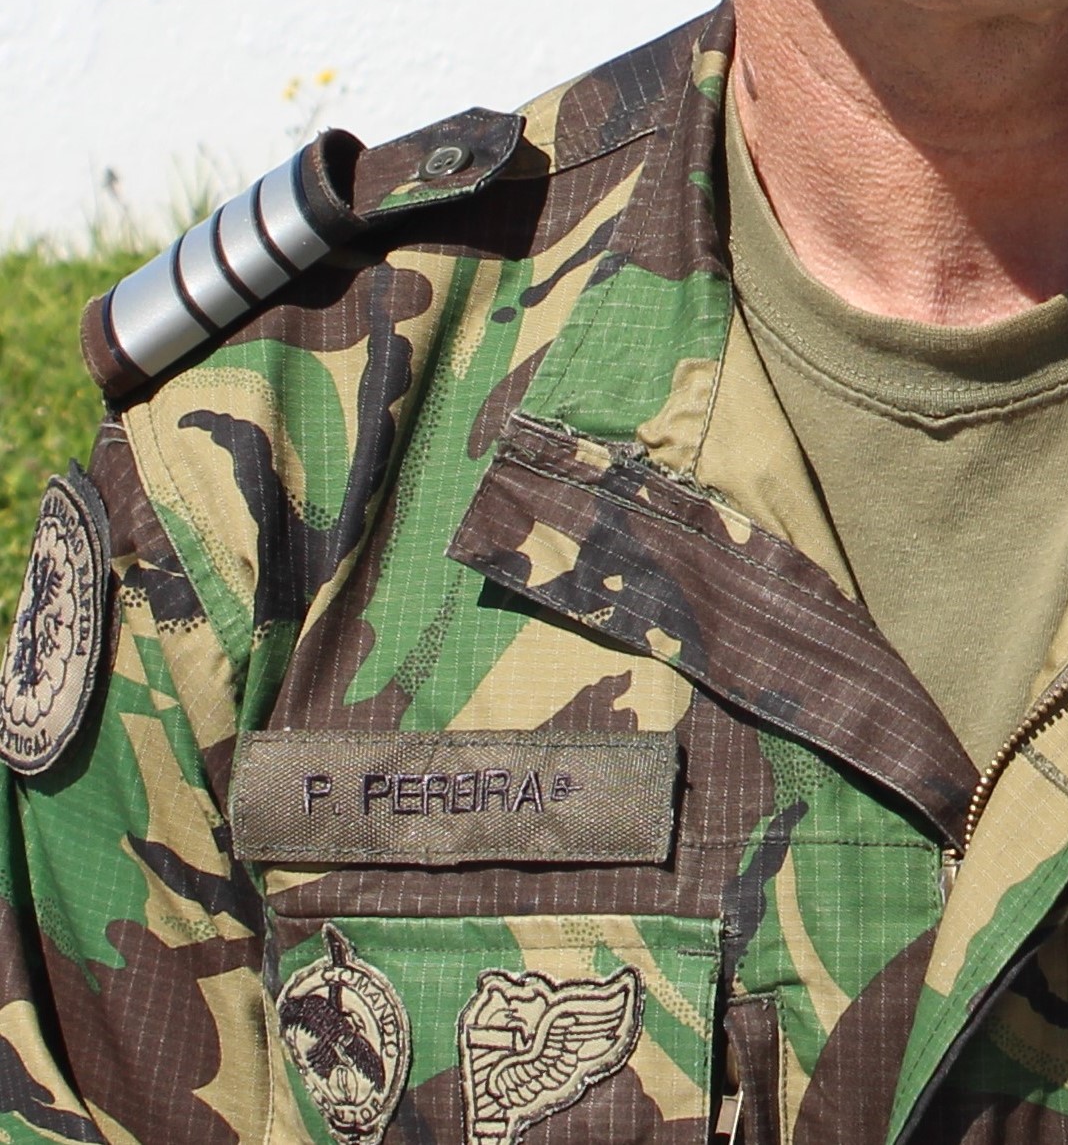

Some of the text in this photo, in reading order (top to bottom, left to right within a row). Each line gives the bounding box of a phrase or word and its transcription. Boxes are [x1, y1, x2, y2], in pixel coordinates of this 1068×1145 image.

[303, 772, 341, 816] P.
[361, 767, 544, 816] PEREIRA
[321, 966, 397, 1058] COMANDO
